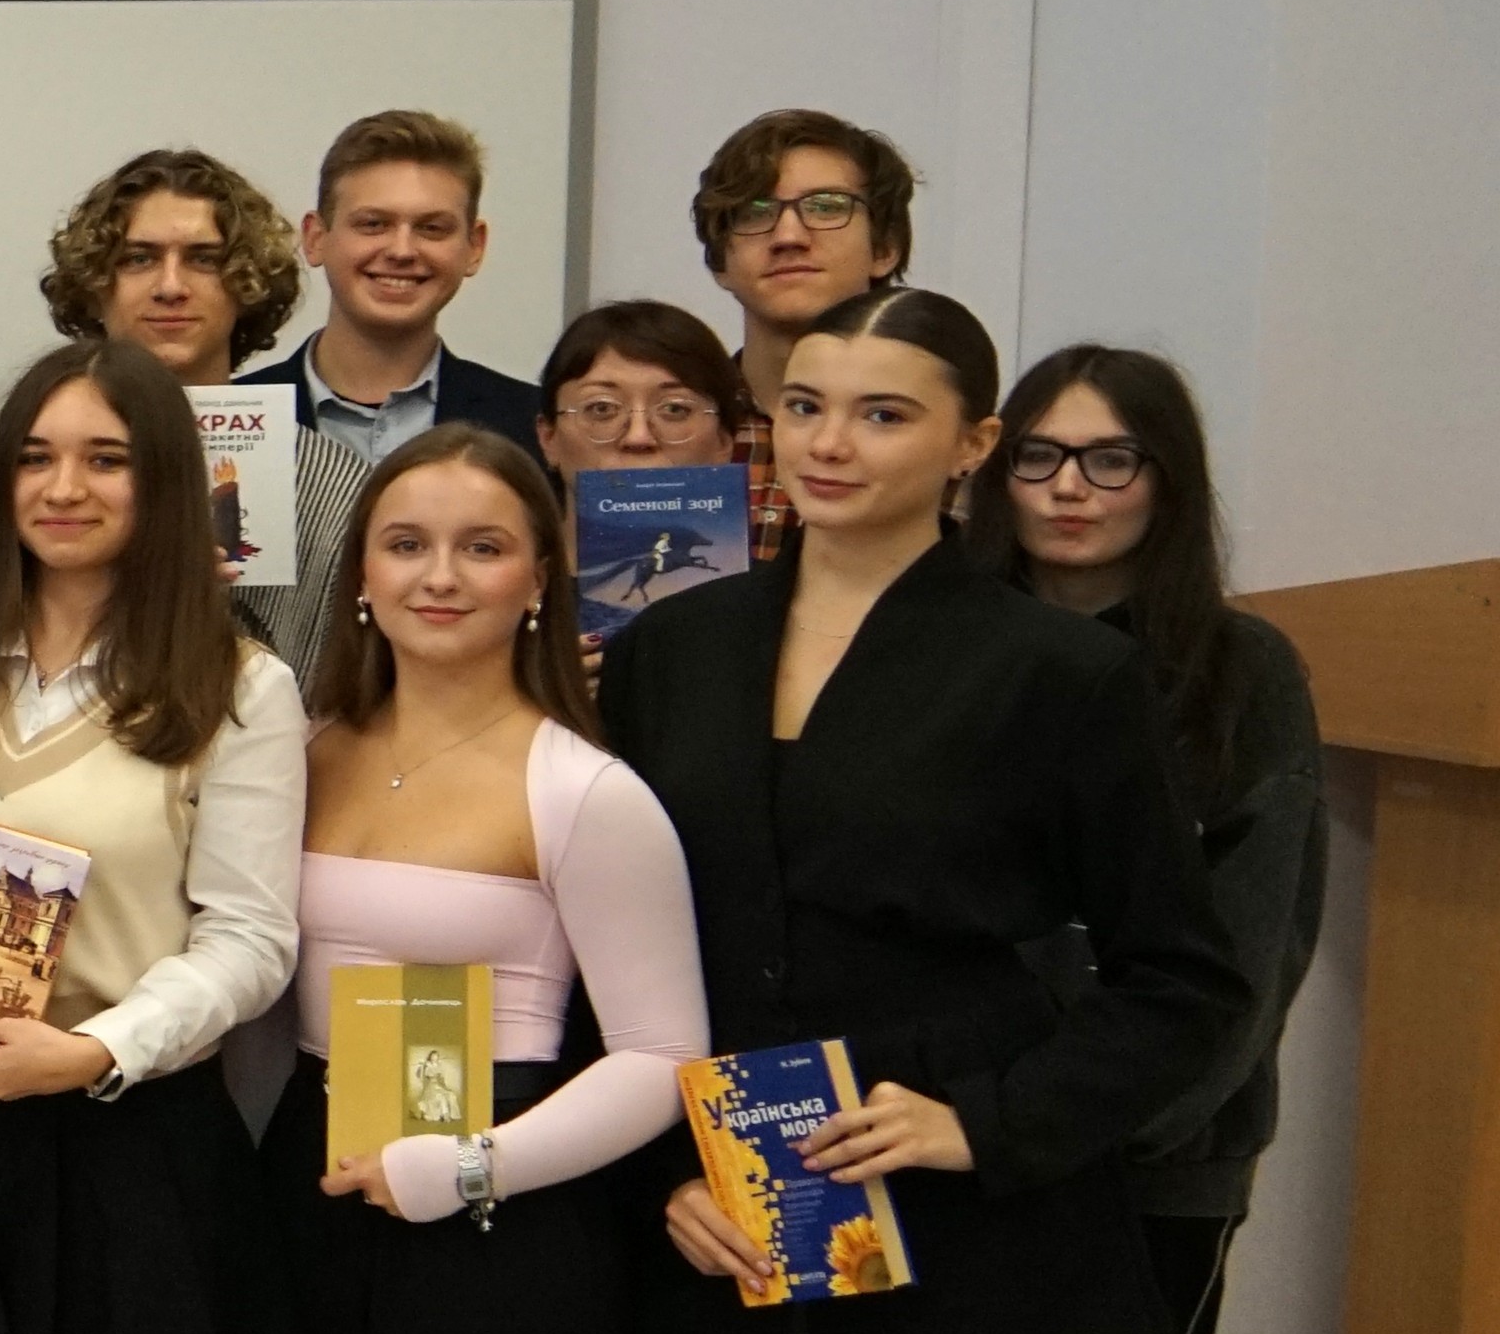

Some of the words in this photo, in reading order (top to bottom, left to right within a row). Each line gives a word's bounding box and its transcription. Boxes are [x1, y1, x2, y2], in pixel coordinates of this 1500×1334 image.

[598, 497, 682, 512] Семенові
[688, 496, 723, 513] зорі
[701, 1096, 826, 1131] Українська
